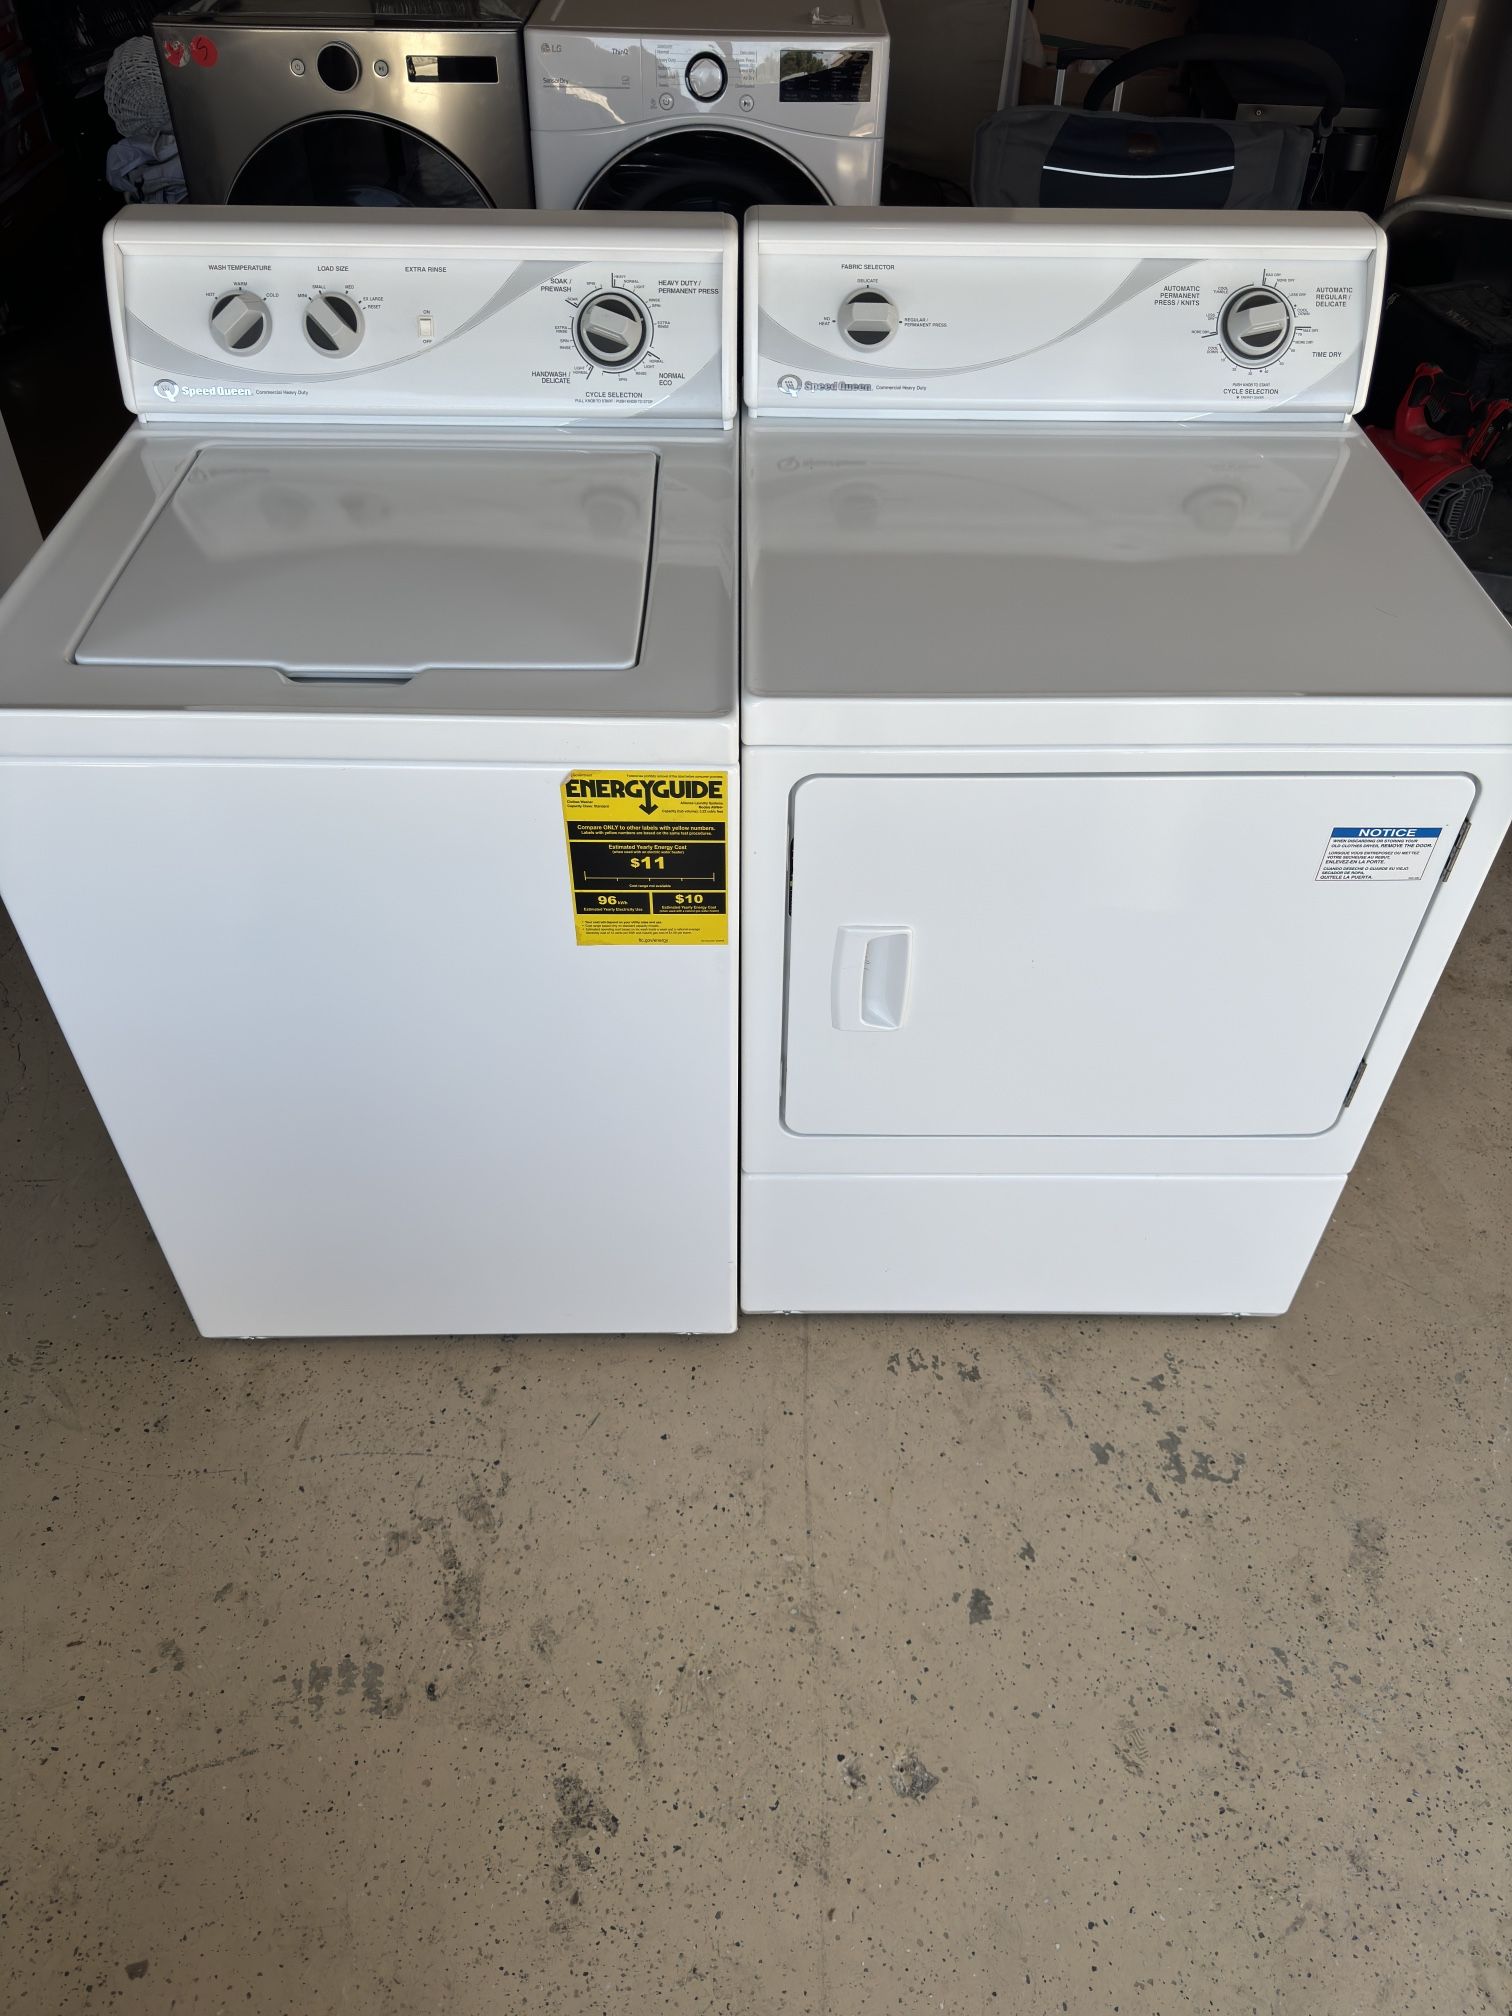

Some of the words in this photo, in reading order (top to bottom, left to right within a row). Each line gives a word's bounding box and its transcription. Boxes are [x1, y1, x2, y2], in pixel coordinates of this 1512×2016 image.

[552, 44, 562, 52] LG
[181, 387, 216, 396] Speed
[217, 386, 251, 396] Queen
[804, 381, 837, 392] Speed
[838, 381, 872, 391] Queen
[566, 779, 722, 799] ENERGYGUIDE
[1358, 828, 1418, 837] NOTICE
[630, 856, 664, 869] $11
[598, 896, 617, 905] 96
[675, 894, 704, 904] $10
